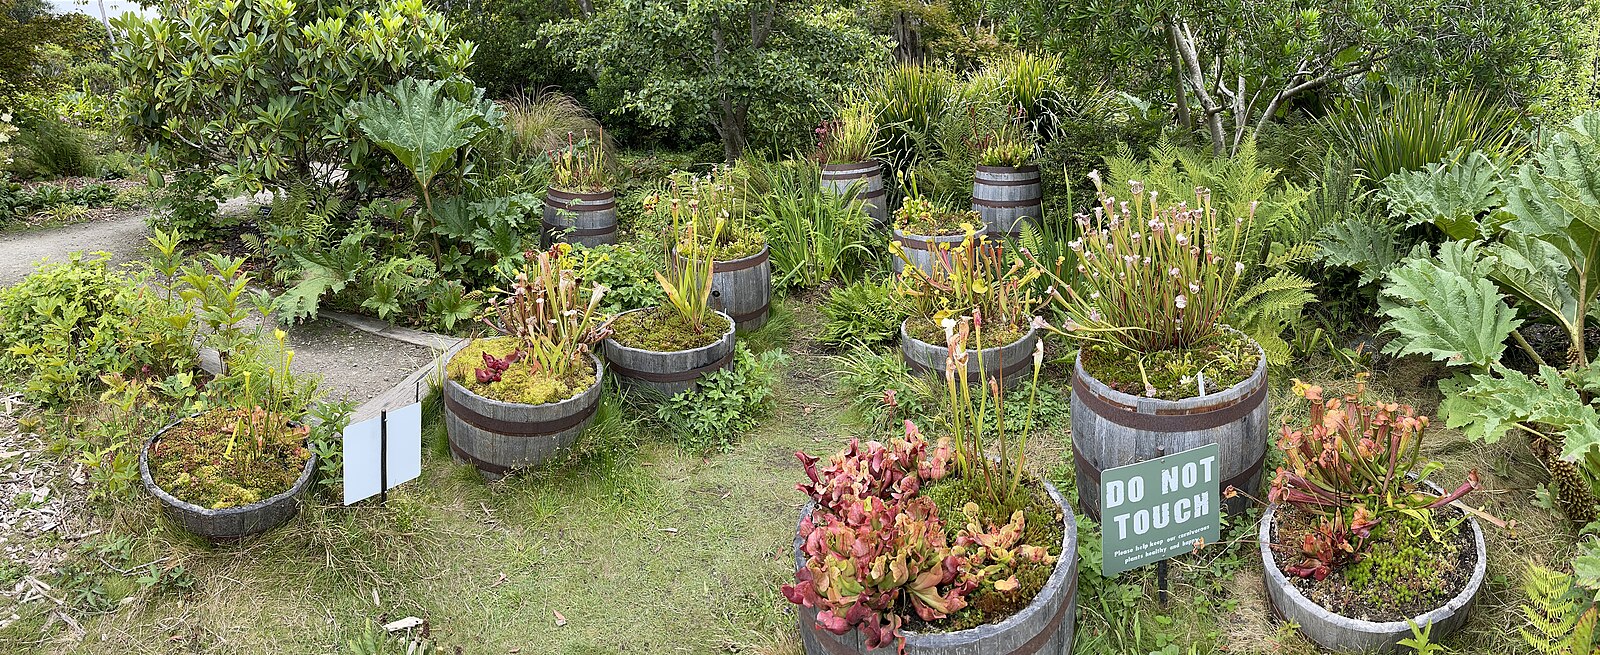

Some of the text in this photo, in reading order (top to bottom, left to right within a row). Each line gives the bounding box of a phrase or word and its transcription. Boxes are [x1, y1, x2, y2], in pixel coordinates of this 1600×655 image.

[1106, 456, 1215, 508] DO NOT
[1113, 491, 1209, 540] TOUCH
[1114, 525, 1210, 557] Please help keep our carnivorous
[1124, 554, 1143, 564] plants
[1145, 547, 1167, 557] healthy
